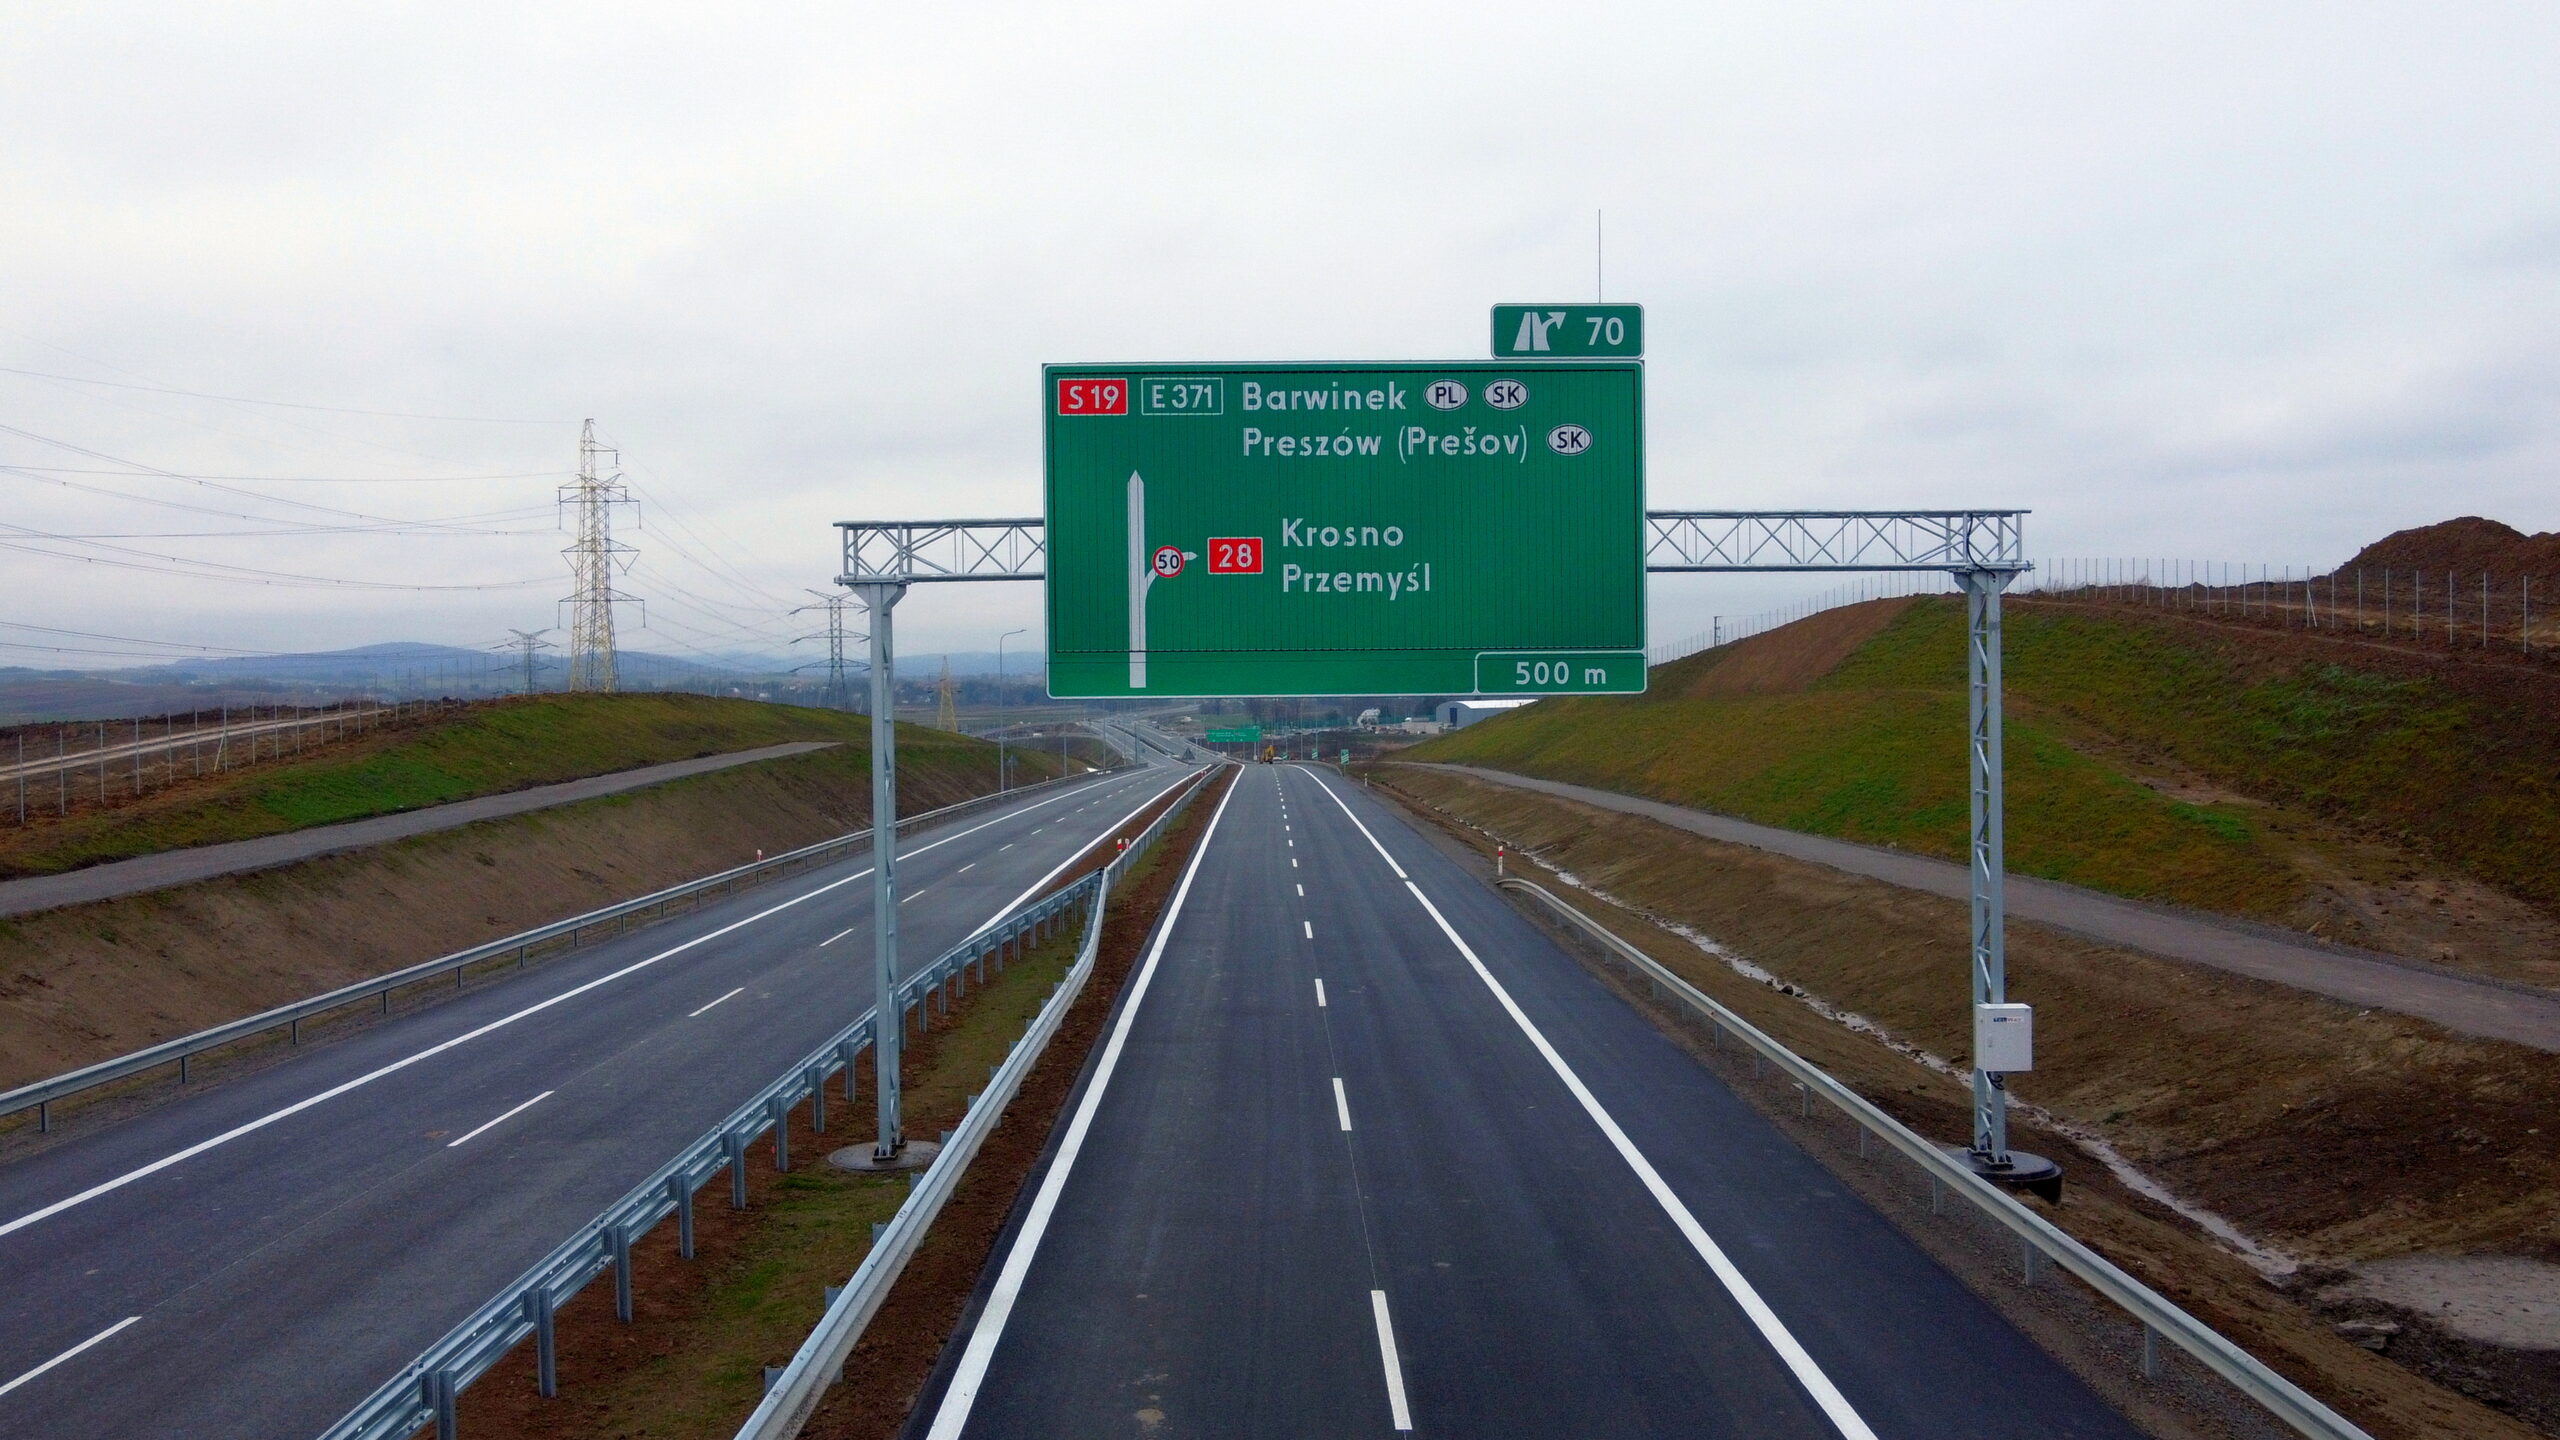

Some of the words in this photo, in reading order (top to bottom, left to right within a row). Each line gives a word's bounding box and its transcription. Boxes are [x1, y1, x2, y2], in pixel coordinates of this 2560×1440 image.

[1586, 317, 1624, 345] 70
[1091, 385, 1119, 410] 19
[1171, 384, 1212, 409] 371
[1244, 381, 1407, 411] Barwinek
[1435, 386, 1459, 404] PL
[1492, 385, 1521, 404] SK
[1245, 427, 1381, 456] Preszów
[1398, 425, 1528, 463] (Prešov)
[1556, 431, 1583, 449] SK
[1282, 518, 1404, 547] Krosno
[1158, 554, 1180, 570] 50
[1218, 543, 1253, 568] 28
[1283, 563, 1431, 601] Przemyśl
[1516, 662, 1569, 685] 500
[1585, 668, 1607, 685] m
